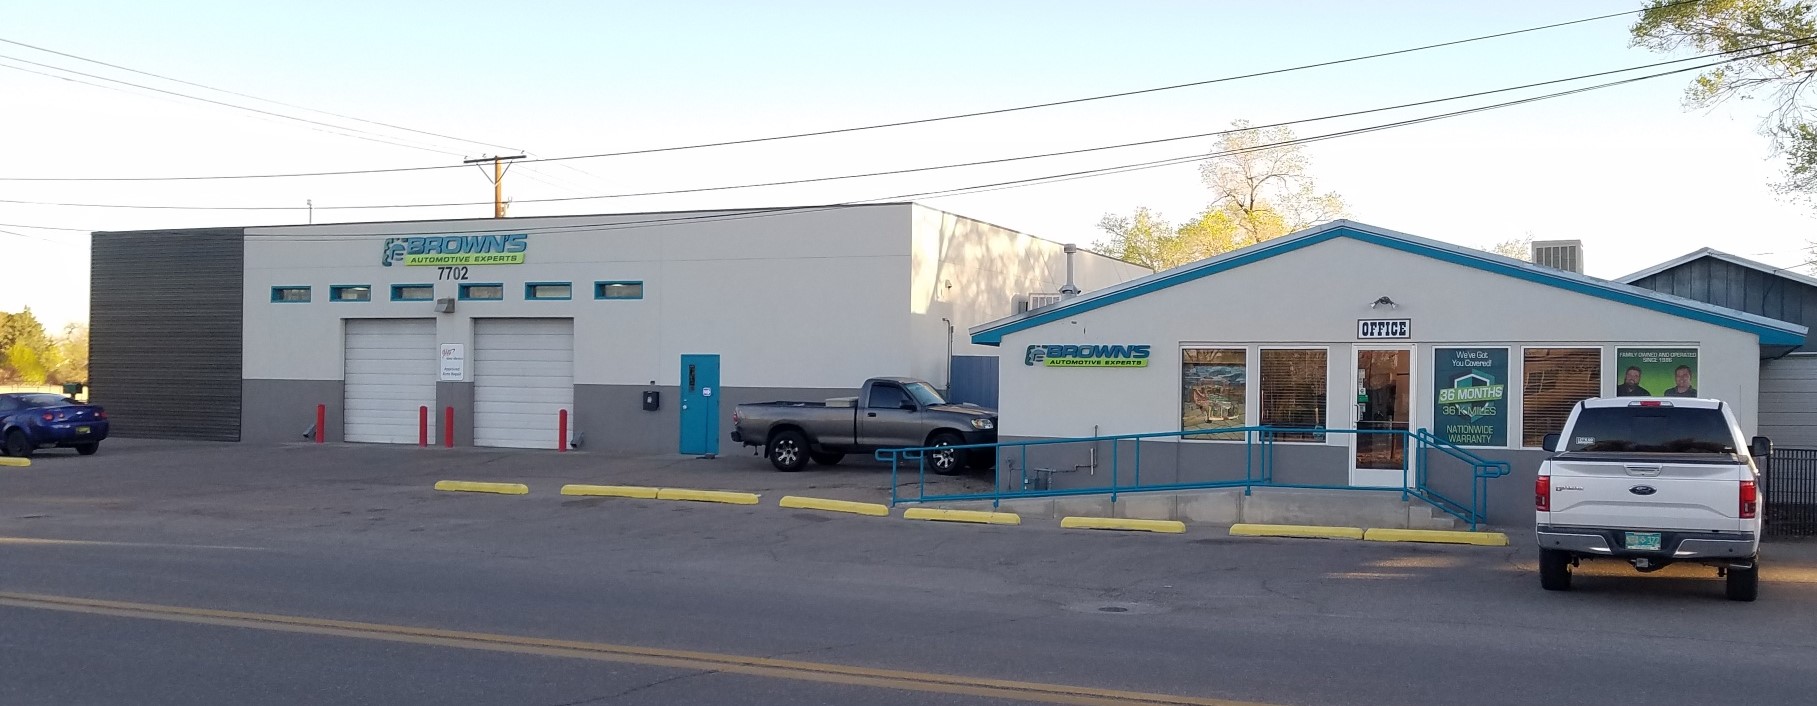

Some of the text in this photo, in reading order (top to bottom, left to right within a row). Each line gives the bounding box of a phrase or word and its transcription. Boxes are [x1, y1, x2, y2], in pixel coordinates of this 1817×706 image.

[407, 234, 527, 254] BROWN'S
[438, 267, 469, 280] 7702
[1362, 321, 1406, 336] OFFICE
[1046, 345, 1151, 358] BROWN'S
[1440, 387, 1503, 401] 36 MONTHS
[1443, 406, 1455, 415] 36
[1447, 425, 1493, 434] NATIONWIDE
[1449, 435, 1491, 443] WARRANTY
